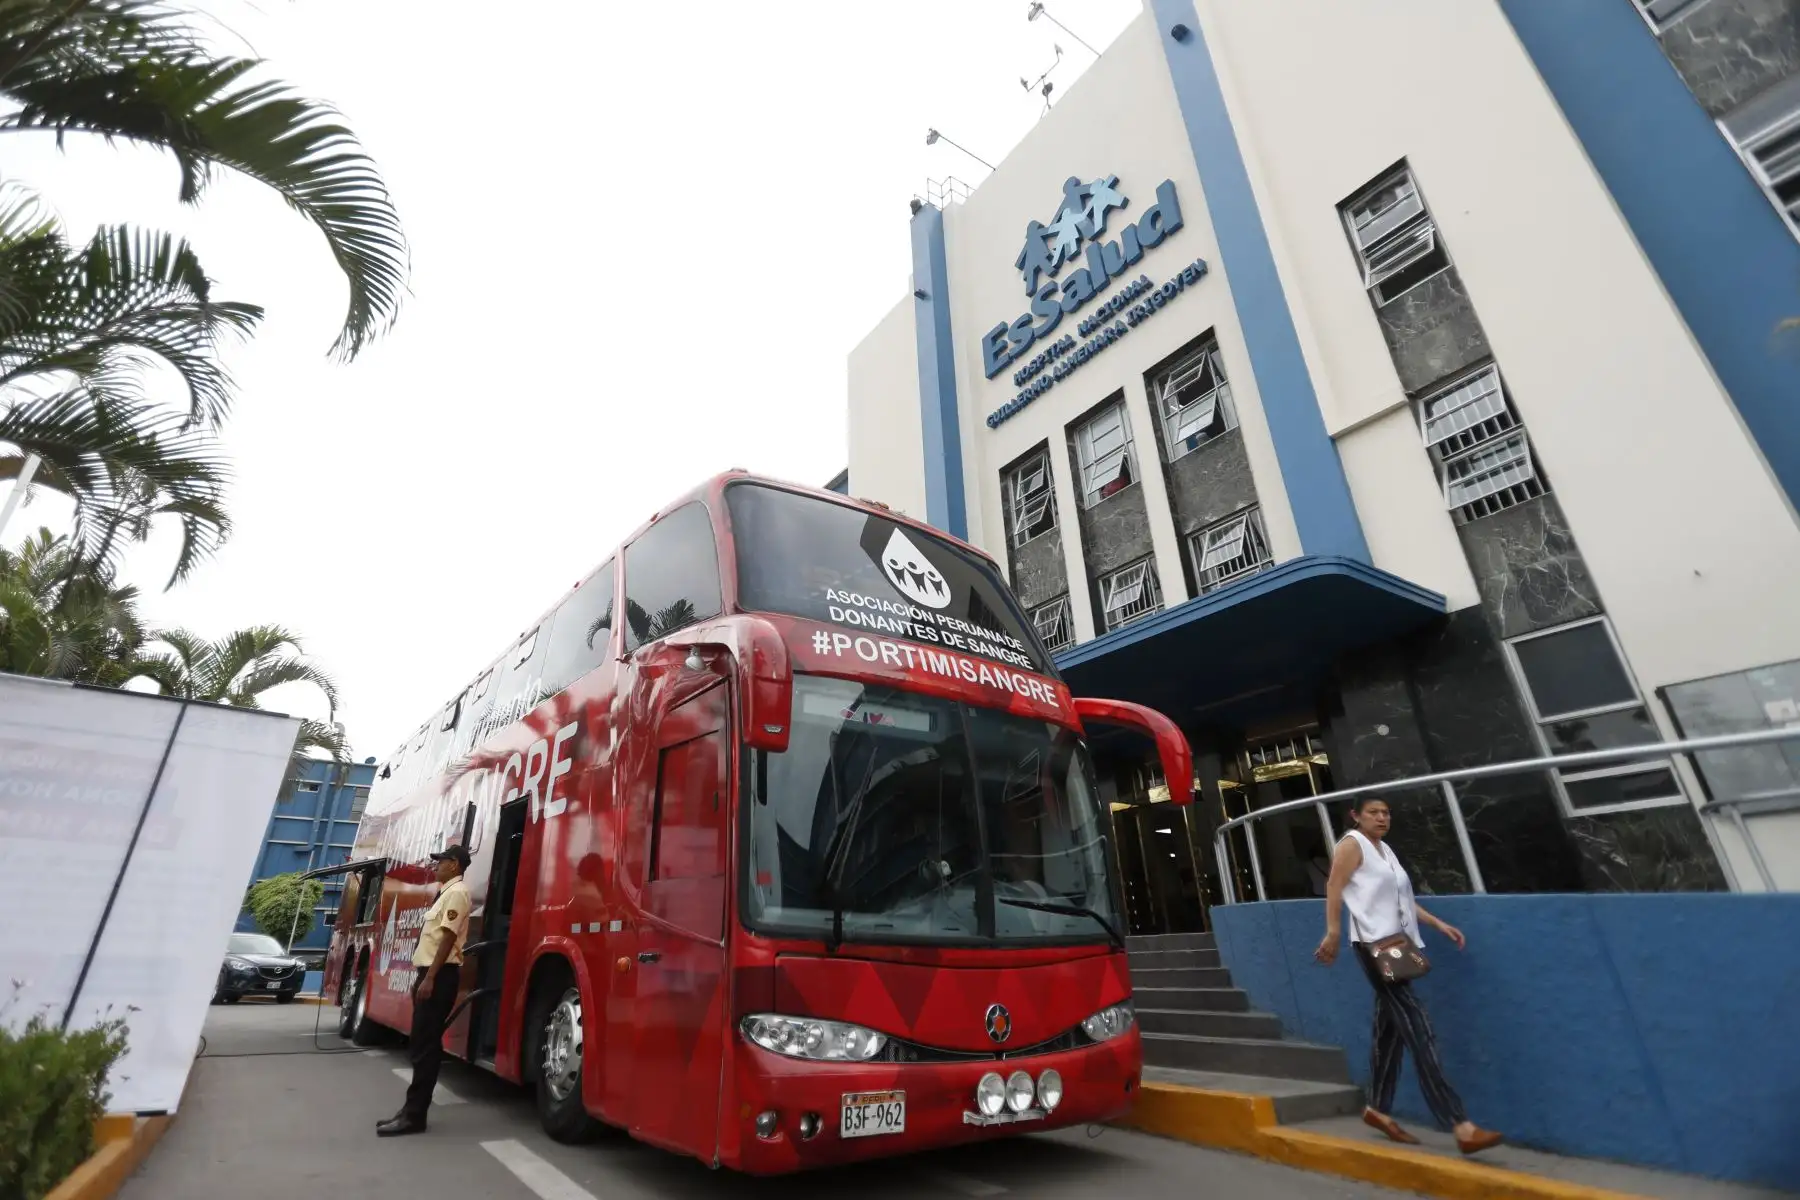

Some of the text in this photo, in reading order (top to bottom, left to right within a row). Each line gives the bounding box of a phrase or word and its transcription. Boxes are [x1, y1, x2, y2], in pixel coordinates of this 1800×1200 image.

[982, 179, 1184, 380] EsSalud
[985, 258, 1208, 429] GUILLERMO ALMENARA IRIGOYEN
[1014, 274, 1154, 387] HOSPITAL NACIONAL
[826, 588, 1025, 653] ASOCIACIÓN PERUANA DE
[829, 605, 1034, 670] DONANTES DE SANGRE
[812, 630, 1060, 708] #PORTIMISANGRE
[844, 1103, 903, 1131] B3F-962
